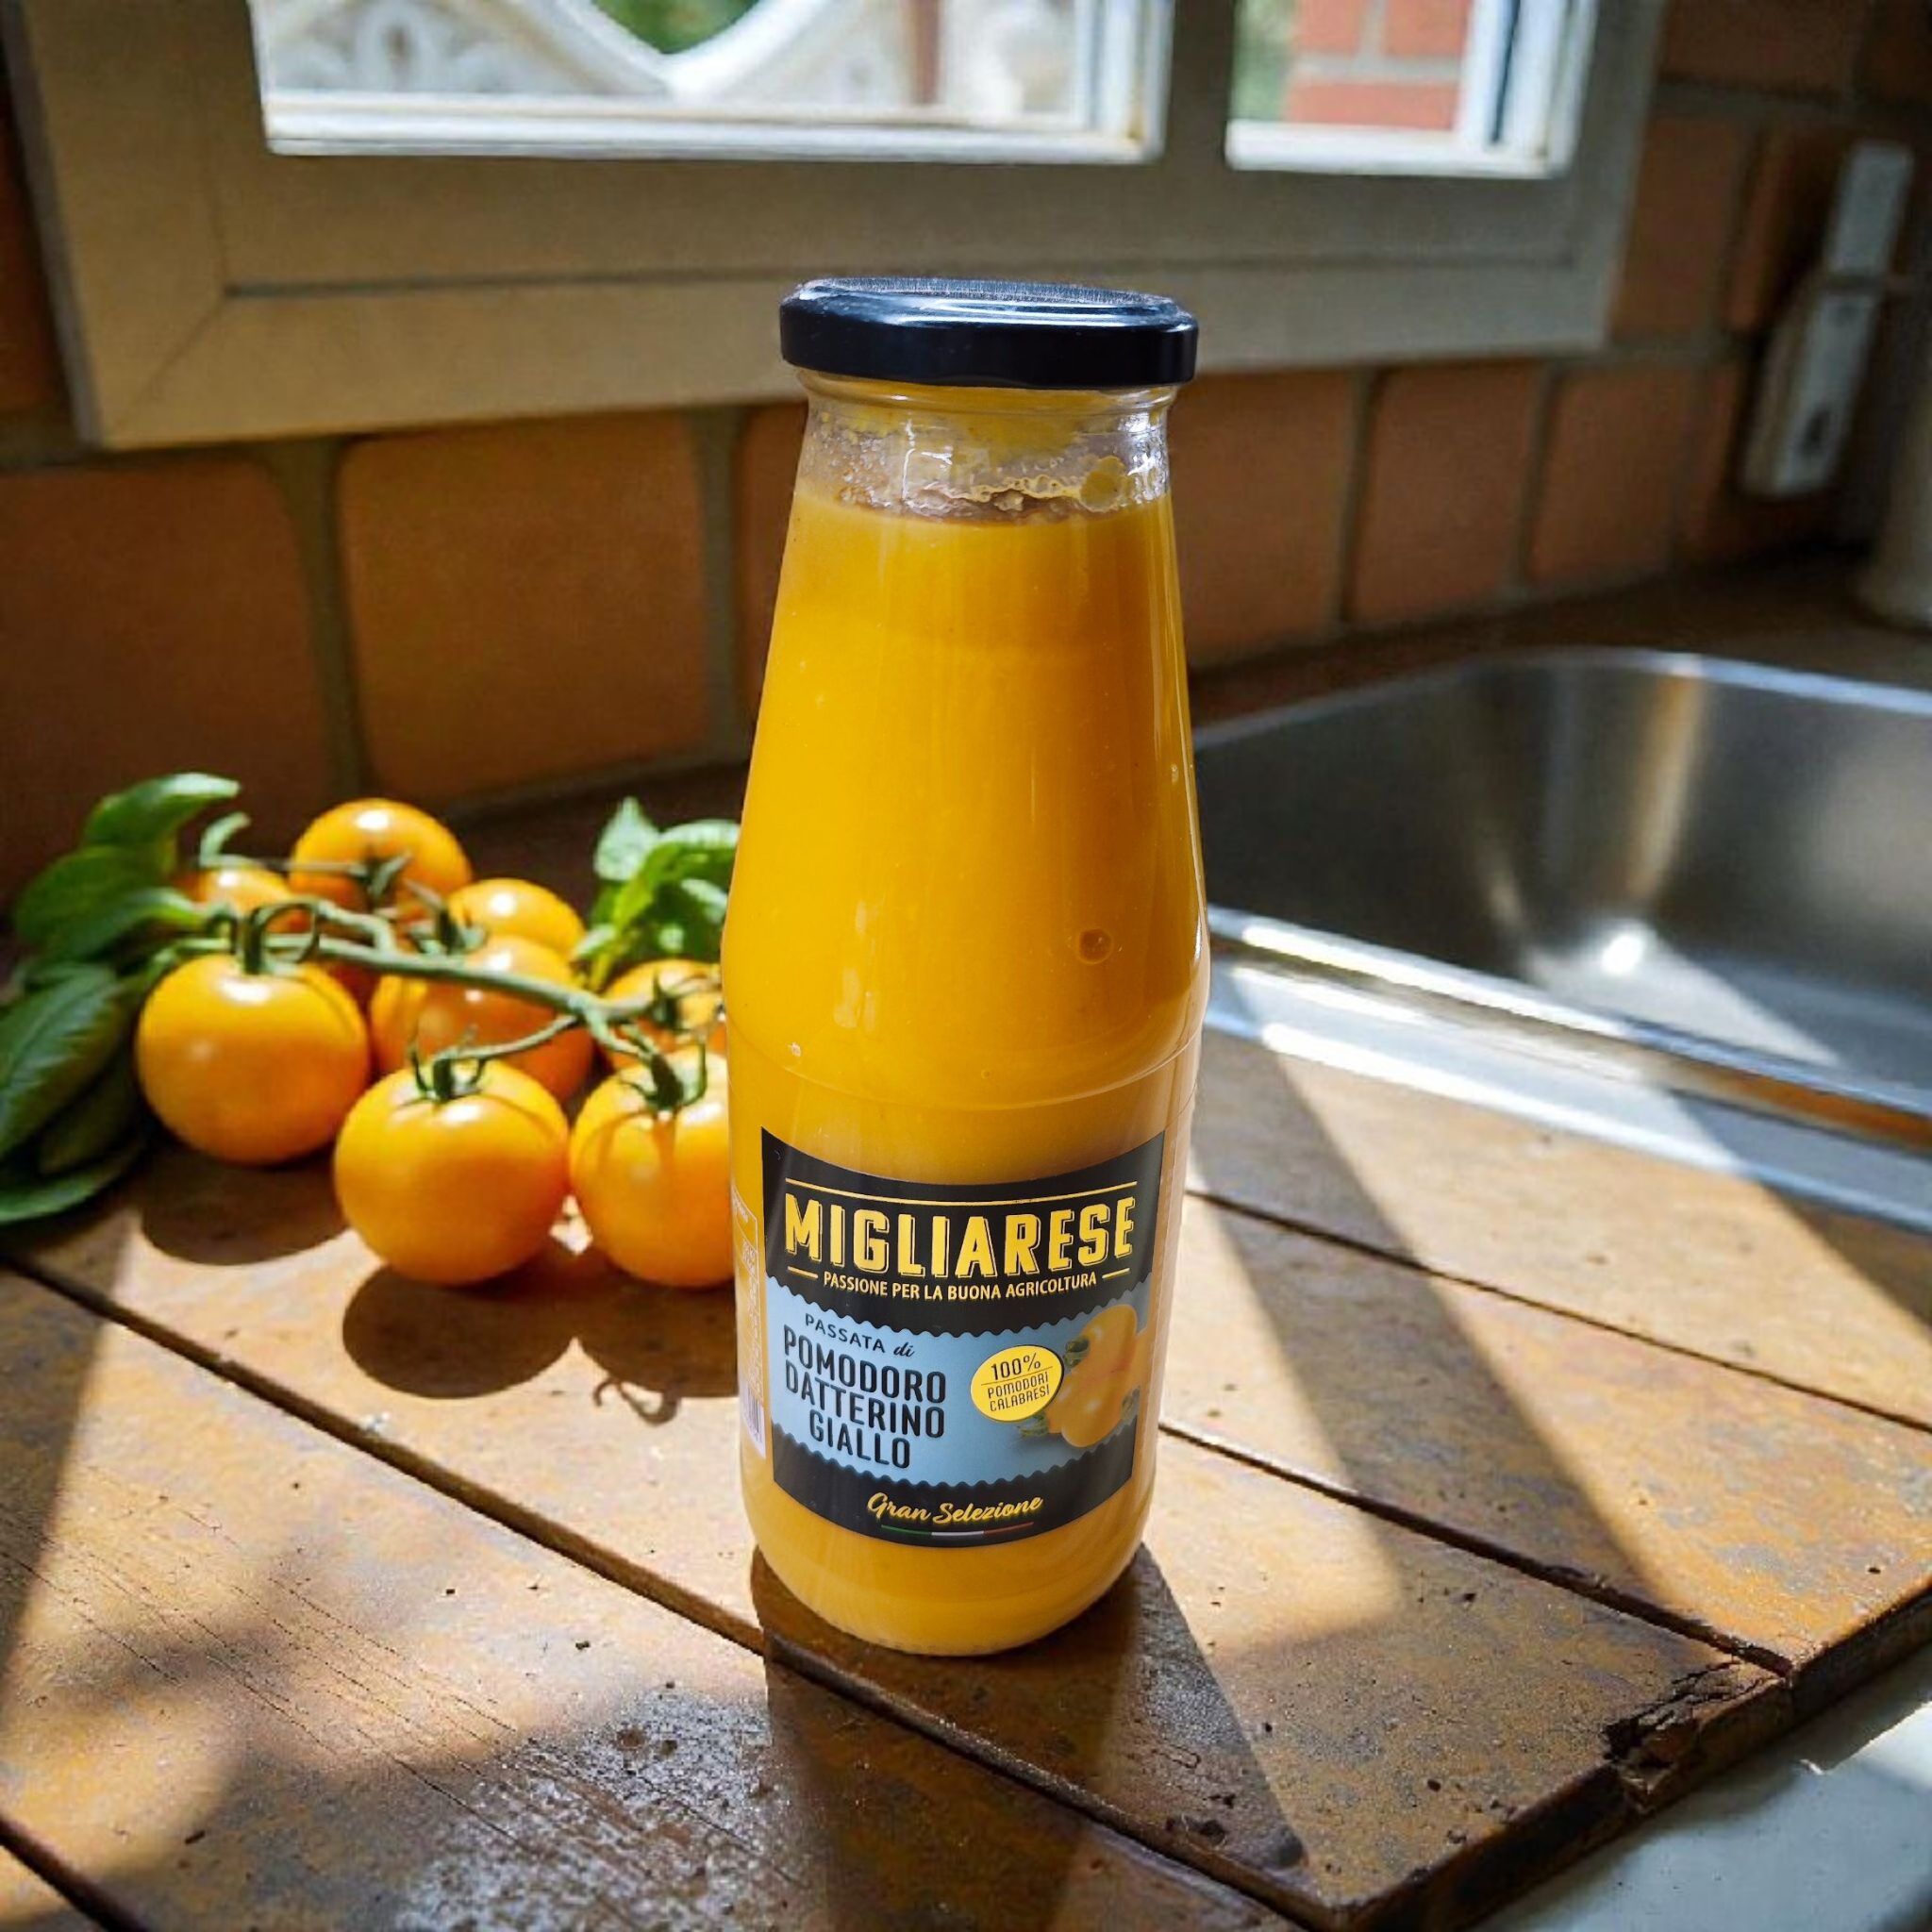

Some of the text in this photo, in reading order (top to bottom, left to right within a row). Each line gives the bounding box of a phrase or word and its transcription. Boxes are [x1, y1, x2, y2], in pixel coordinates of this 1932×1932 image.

[785, 1192, 1135, 1278] MIGLIARESE
[824, 1271, 1097, 1301] PASSIONE PER LA BUONA AGRICOLTURA
[805, 1312, 915, 1357] PASSATA di
[784, 1324, 946, 1404] POMODORO
[991, 1352, 1041, 1381] 100%
[785, 1359, 945, 1439] DATTERINO
[987, 1371, 1049, 1399] POMODORI
[990, 1384, 1050, 1412] CALABRESI
[809, 1408, 910, 1469] GIALLO
[866, 1491, 1044, 1524] Gran Selezione
